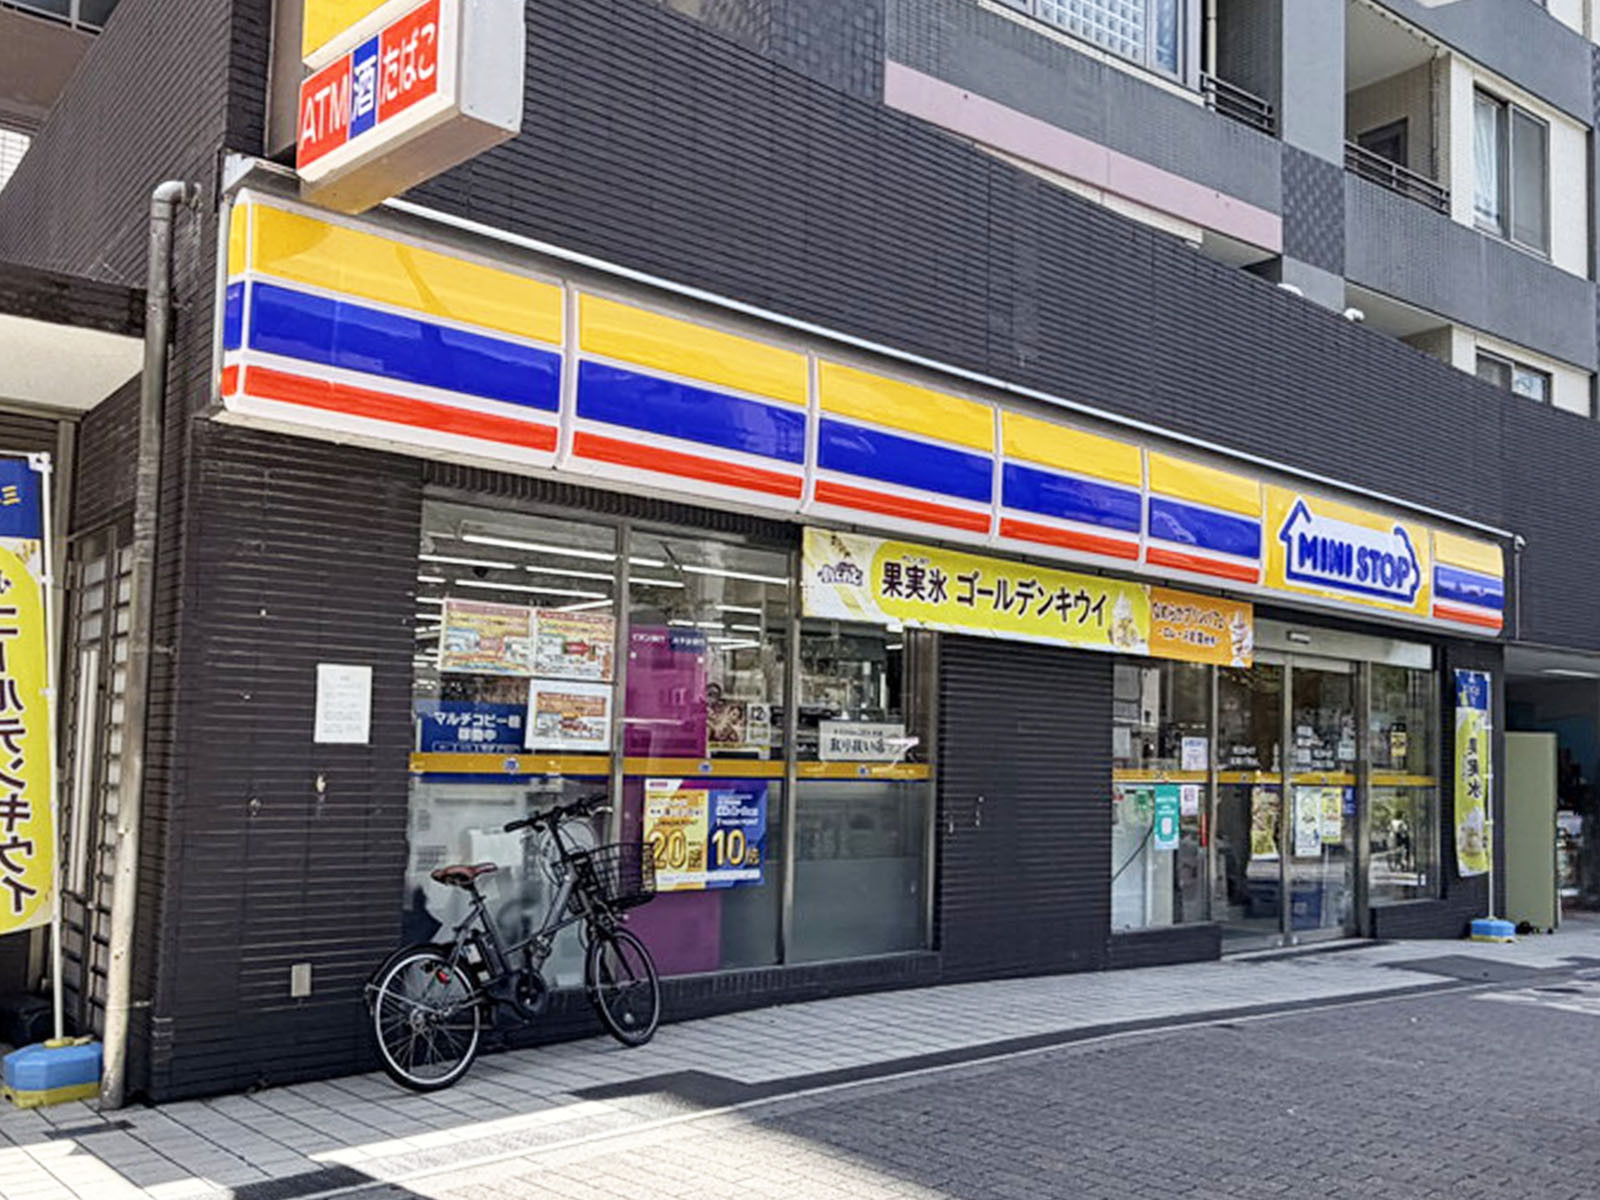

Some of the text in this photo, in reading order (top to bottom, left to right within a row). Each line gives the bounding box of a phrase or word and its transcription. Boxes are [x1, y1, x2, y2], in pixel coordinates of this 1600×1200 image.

[300, 22, 436, 150] ATM 酒 たばこ
[1299, 531, 1410, 589] MINI STOP
[881, 561, 948, 602] 果実氷
[956, 571, 1107, 626] ゴールデンキウイ
